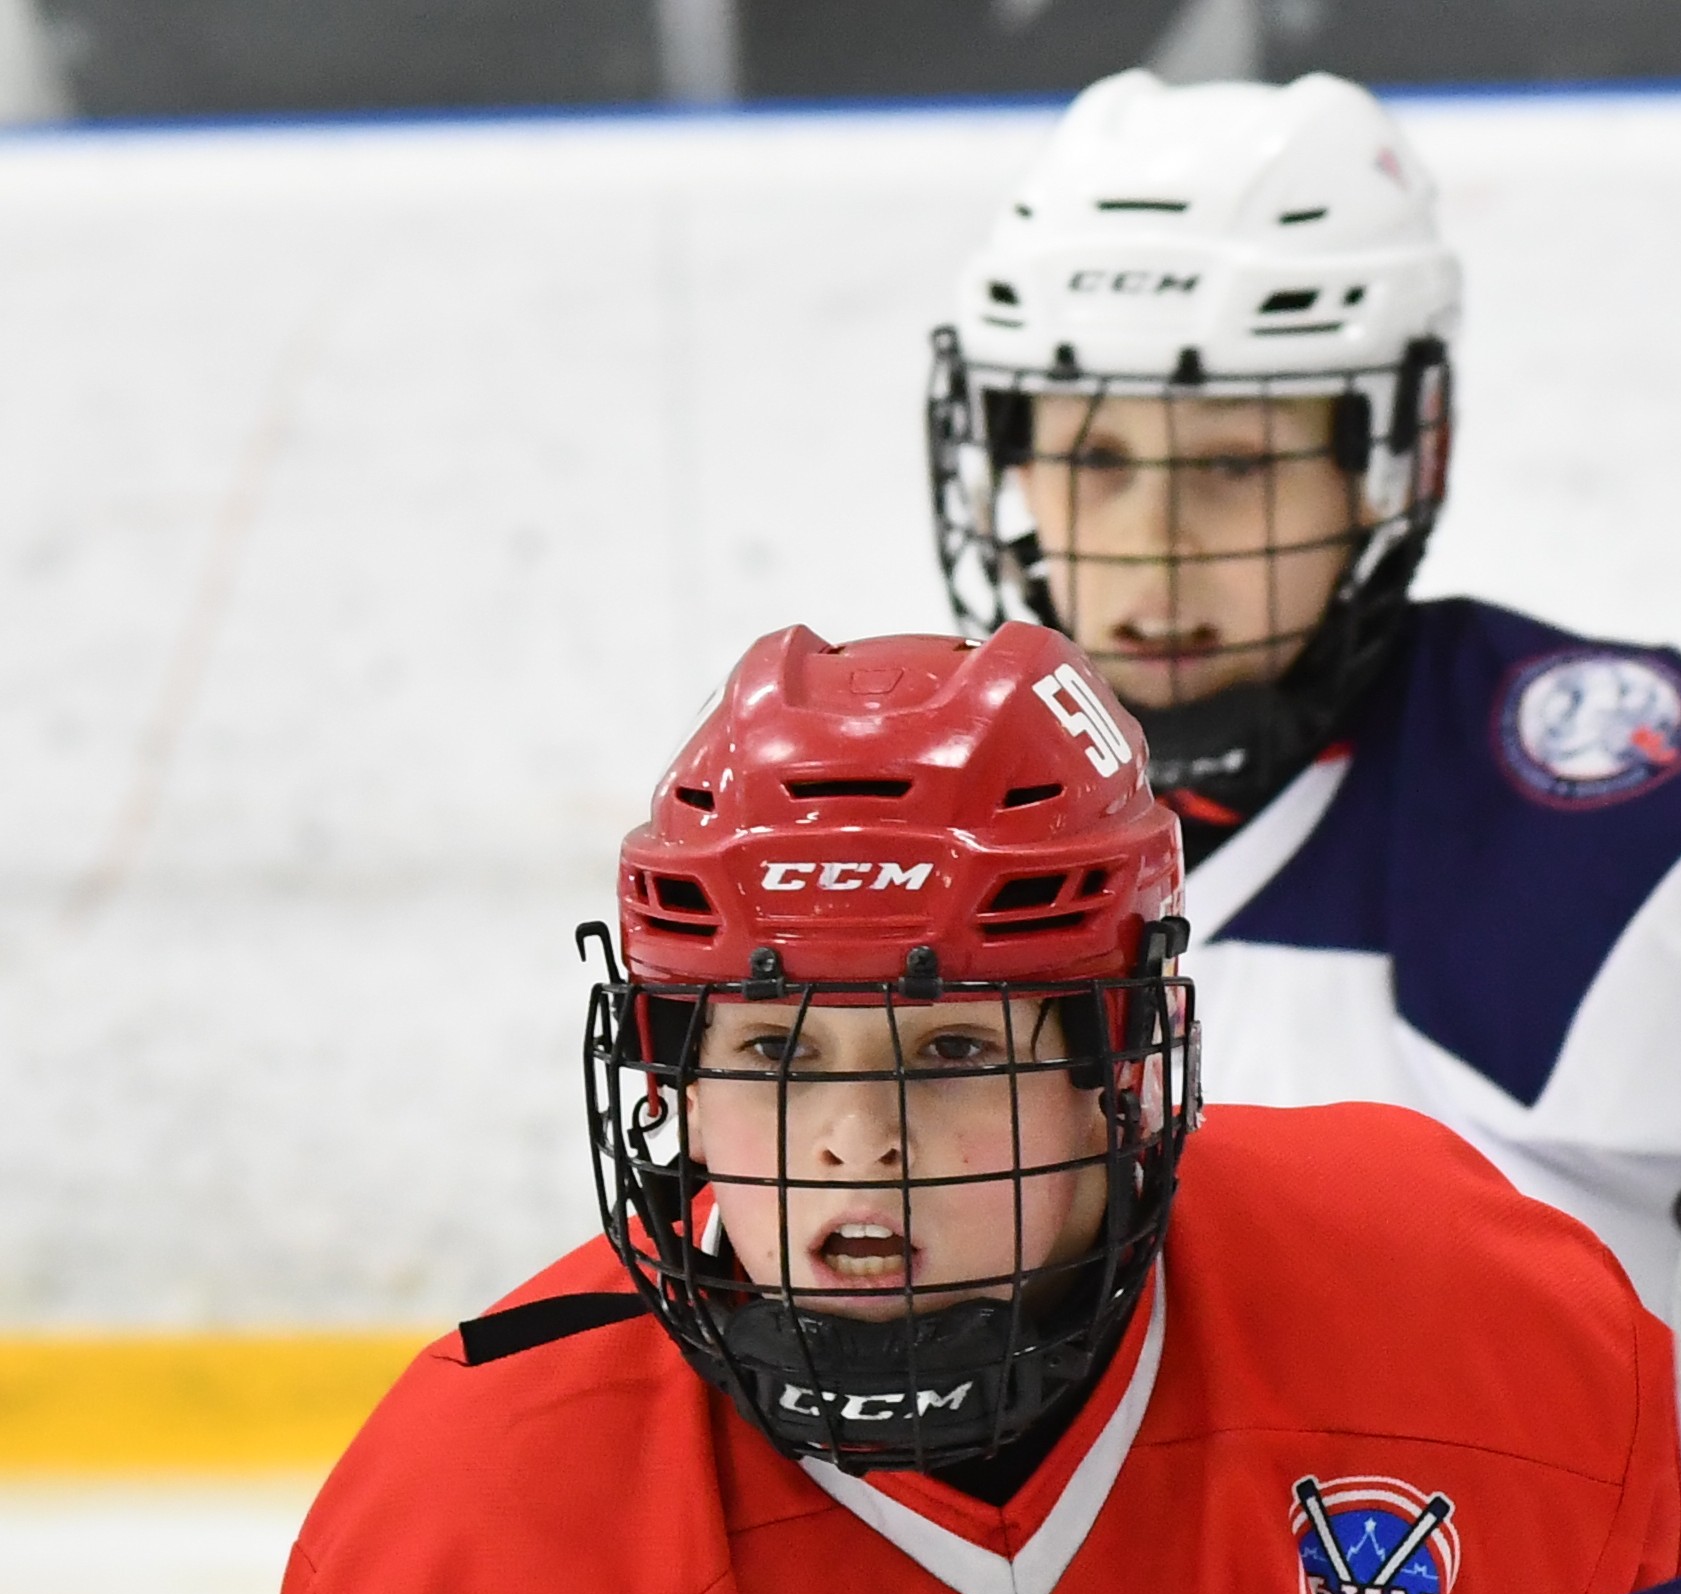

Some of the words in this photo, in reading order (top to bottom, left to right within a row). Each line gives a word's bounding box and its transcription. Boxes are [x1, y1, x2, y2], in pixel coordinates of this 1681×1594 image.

[1066, 268, 1202, 297] CCM
[1032, 662, 1132, 778] 50
[761, 861, 935, 891] CCM
[778, 1382, 974, 1421] CCM
